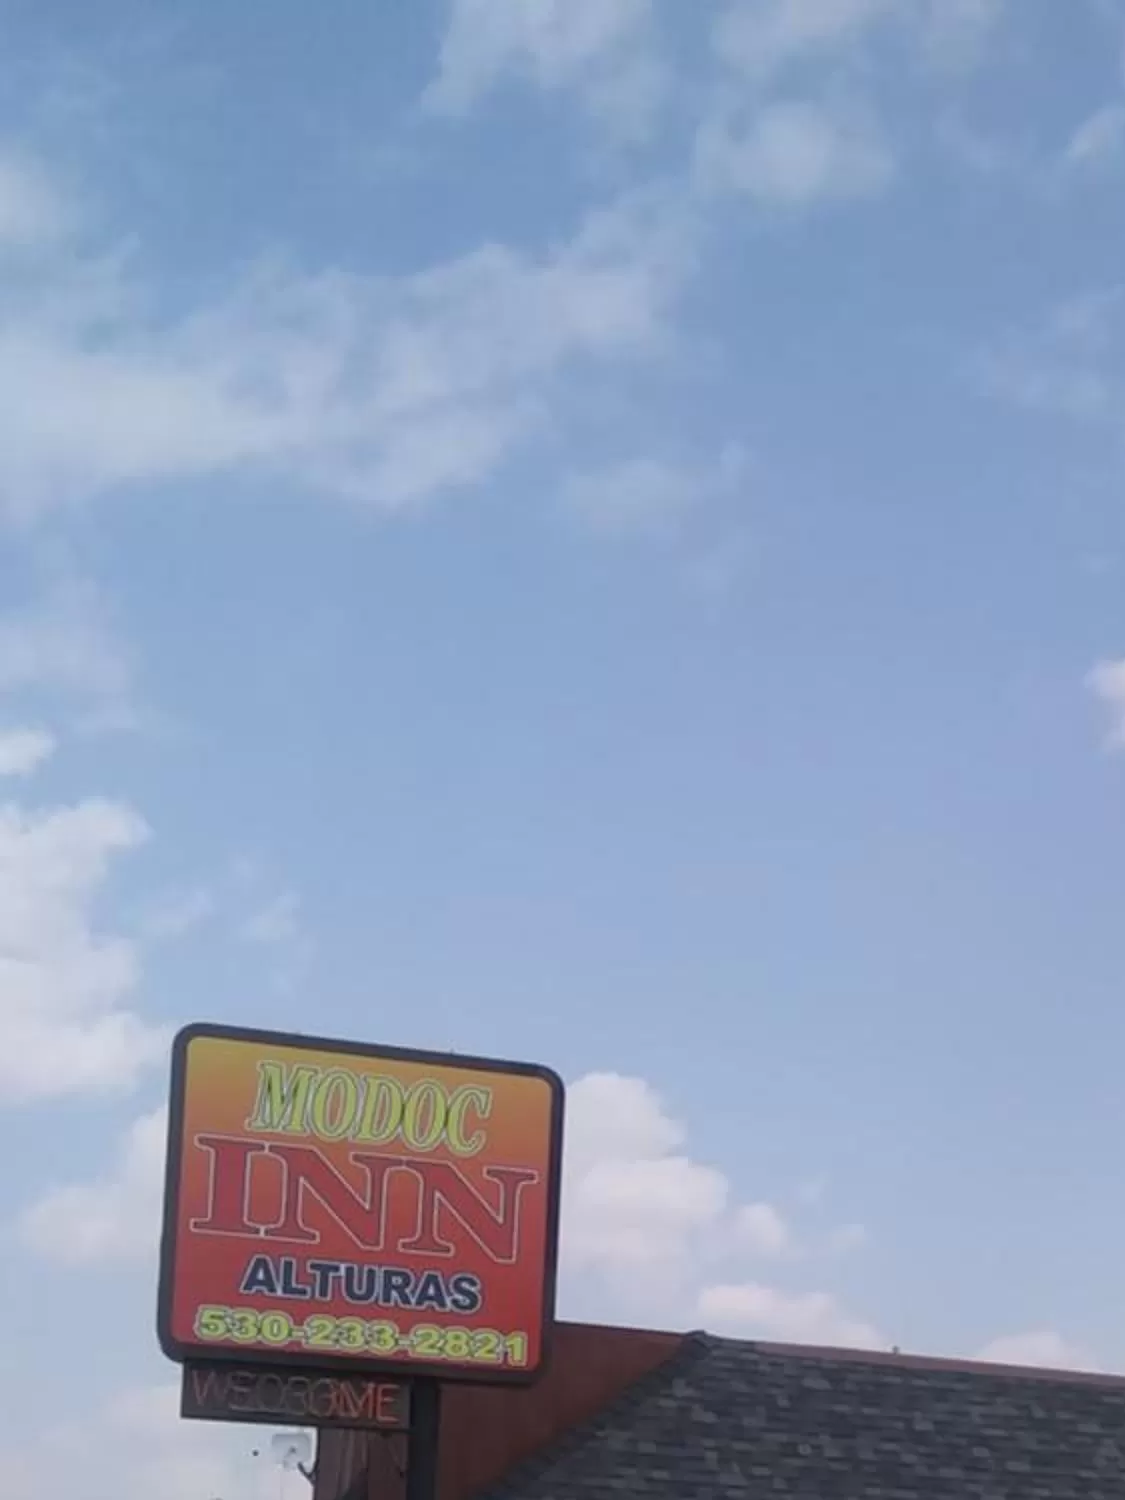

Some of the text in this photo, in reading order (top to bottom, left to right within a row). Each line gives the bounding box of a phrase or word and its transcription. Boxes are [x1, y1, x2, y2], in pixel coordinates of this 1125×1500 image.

[247, 1062, 491, 1153] MODOC
[191, 1135, 537, 1263] INN
[240, 1256, 481, 1312] ALTURAS
[195, 1307, 528, 1367] 530-233-2821
